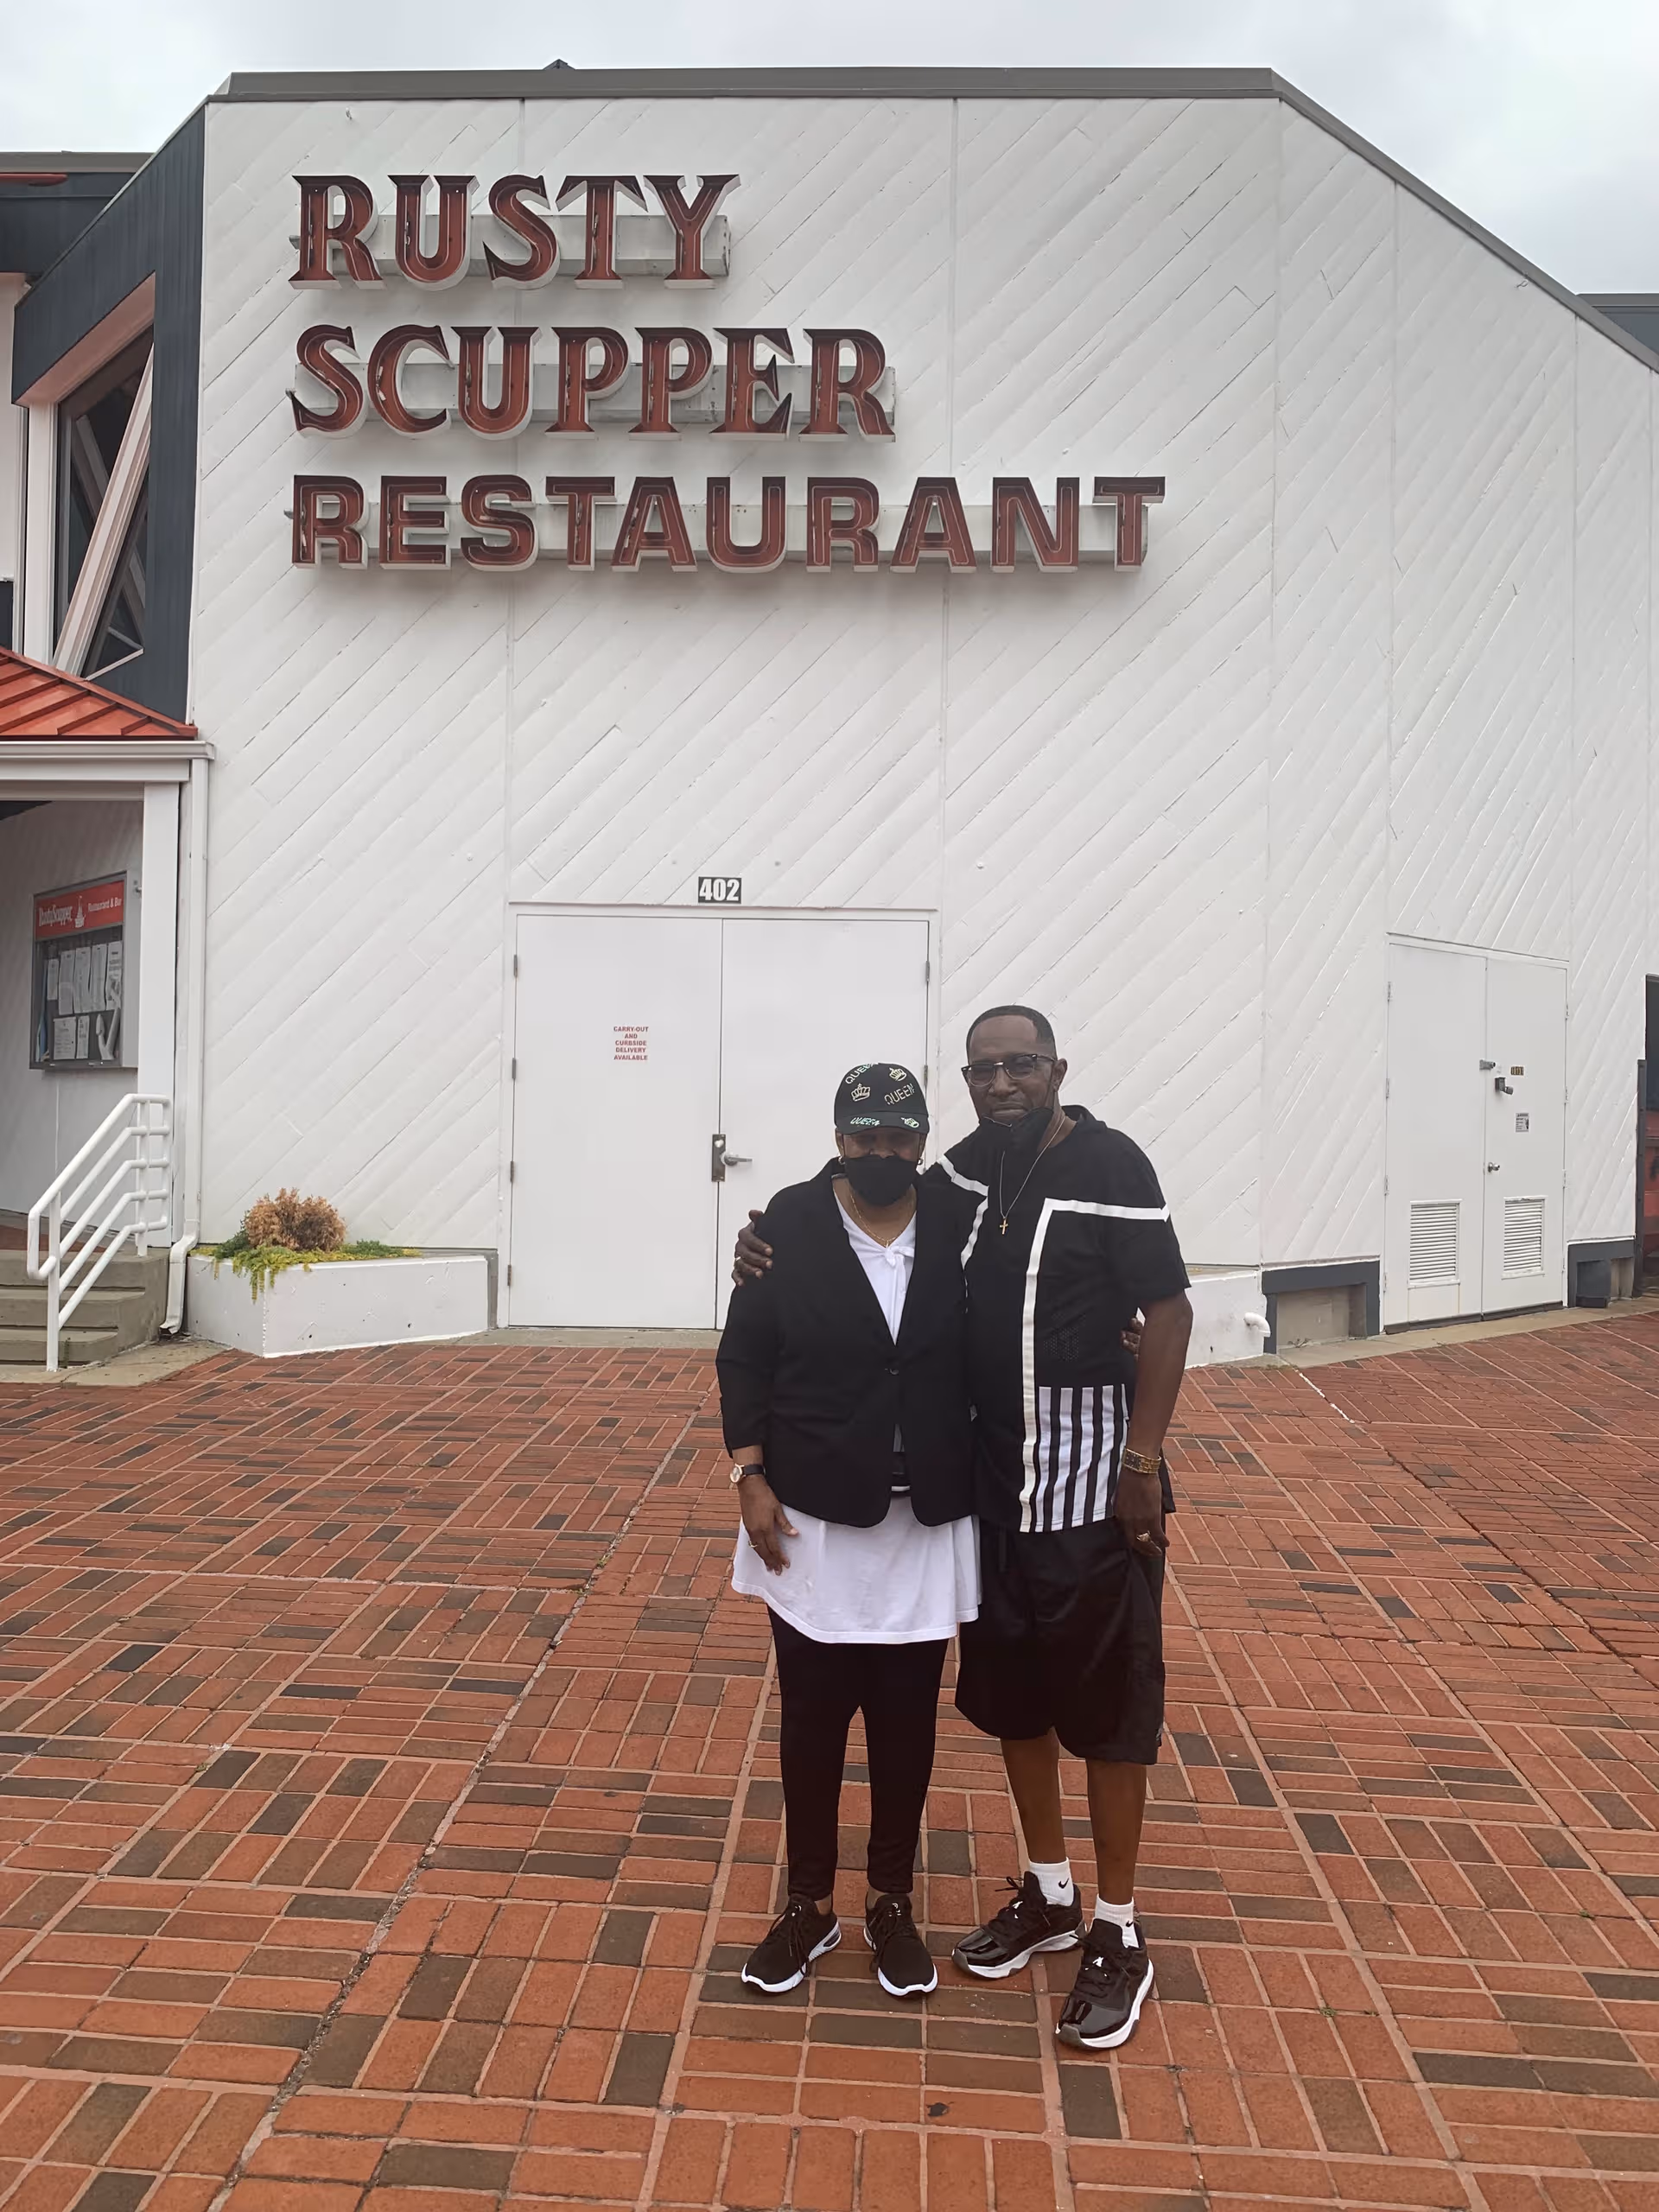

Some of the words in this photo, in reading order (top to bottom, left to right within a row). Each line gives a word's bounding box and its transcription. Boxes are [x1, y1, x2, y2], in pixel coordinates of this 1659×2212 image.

[288, 174, 740, 289] RUSTY
[288, 324, 896, 441] SCUPPER
[292, 474, 1166, 574] RESTAURANT
[699, 878, 740, 901] 402
[884, 1083, 915, 1105] QUEEN
